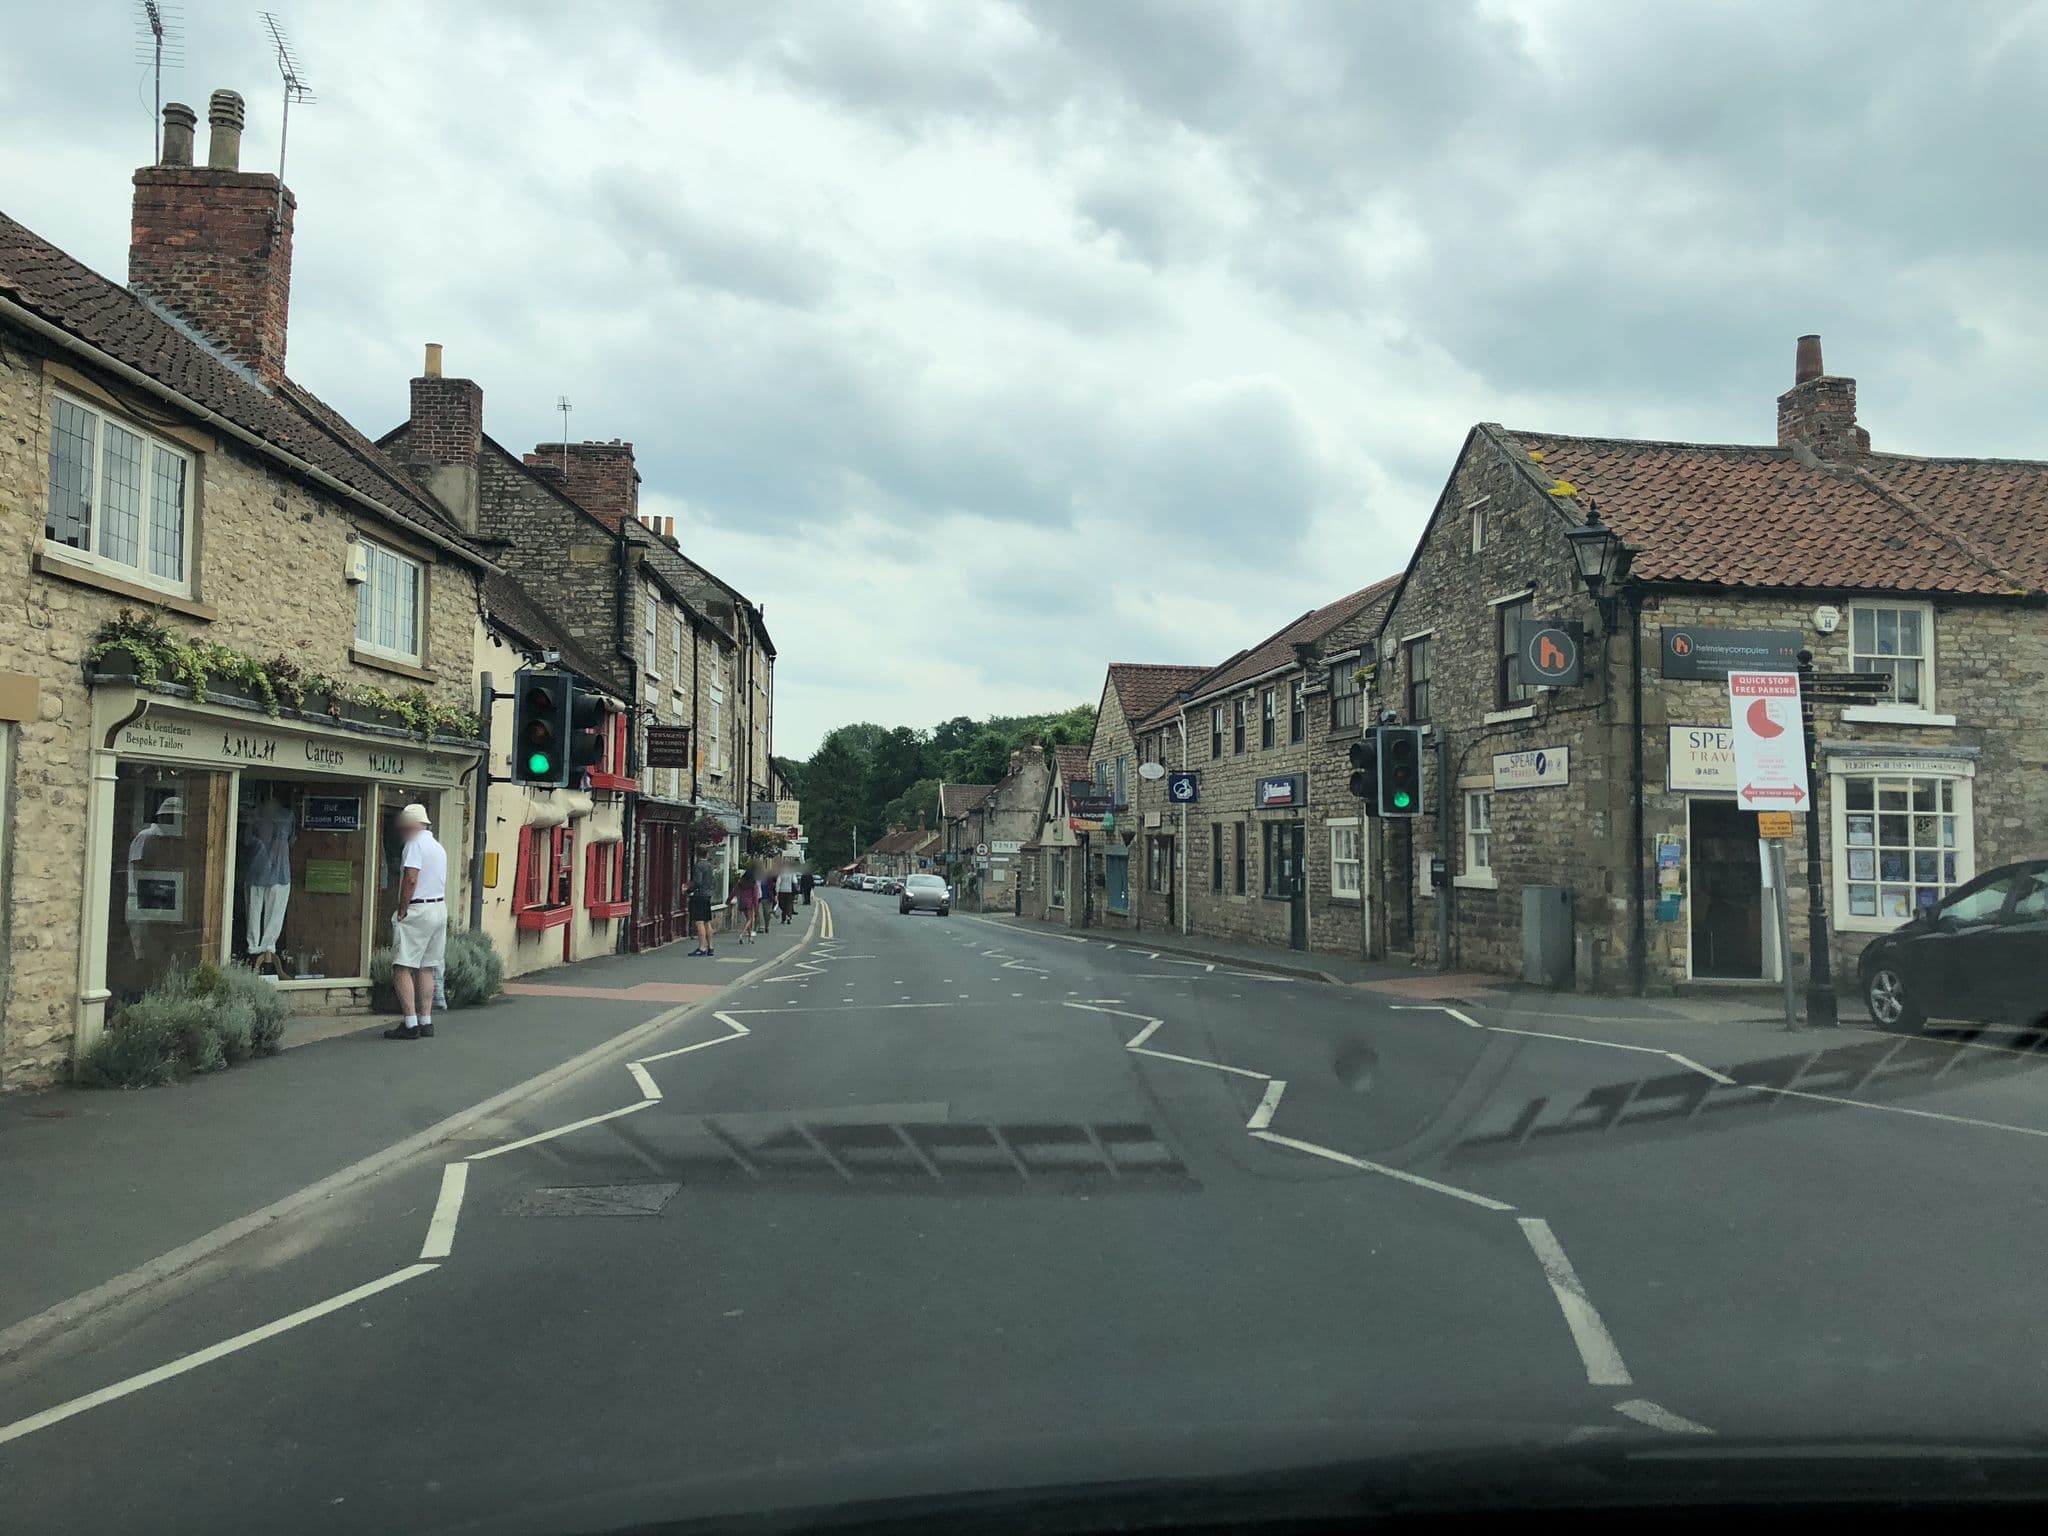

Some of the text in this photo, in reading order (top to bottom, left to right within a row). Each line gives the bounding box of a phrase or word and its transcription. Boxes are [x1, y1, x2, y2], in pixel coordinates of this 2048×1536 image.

[1696, 643, 1769, 656] helmsleycomputers
[1739, 677, 1766, 685] QUICK
[1735, 686, 1796, 695] FREE PARKING
[144, 719, 151, 731] &
[153, 720, 192, 736] Gentlemen
[126, 731, 184, 750] Bespoke Tailors
[305, 739, 344, 766] Carters
[1510, 752, 1536, 768] SPEAR
